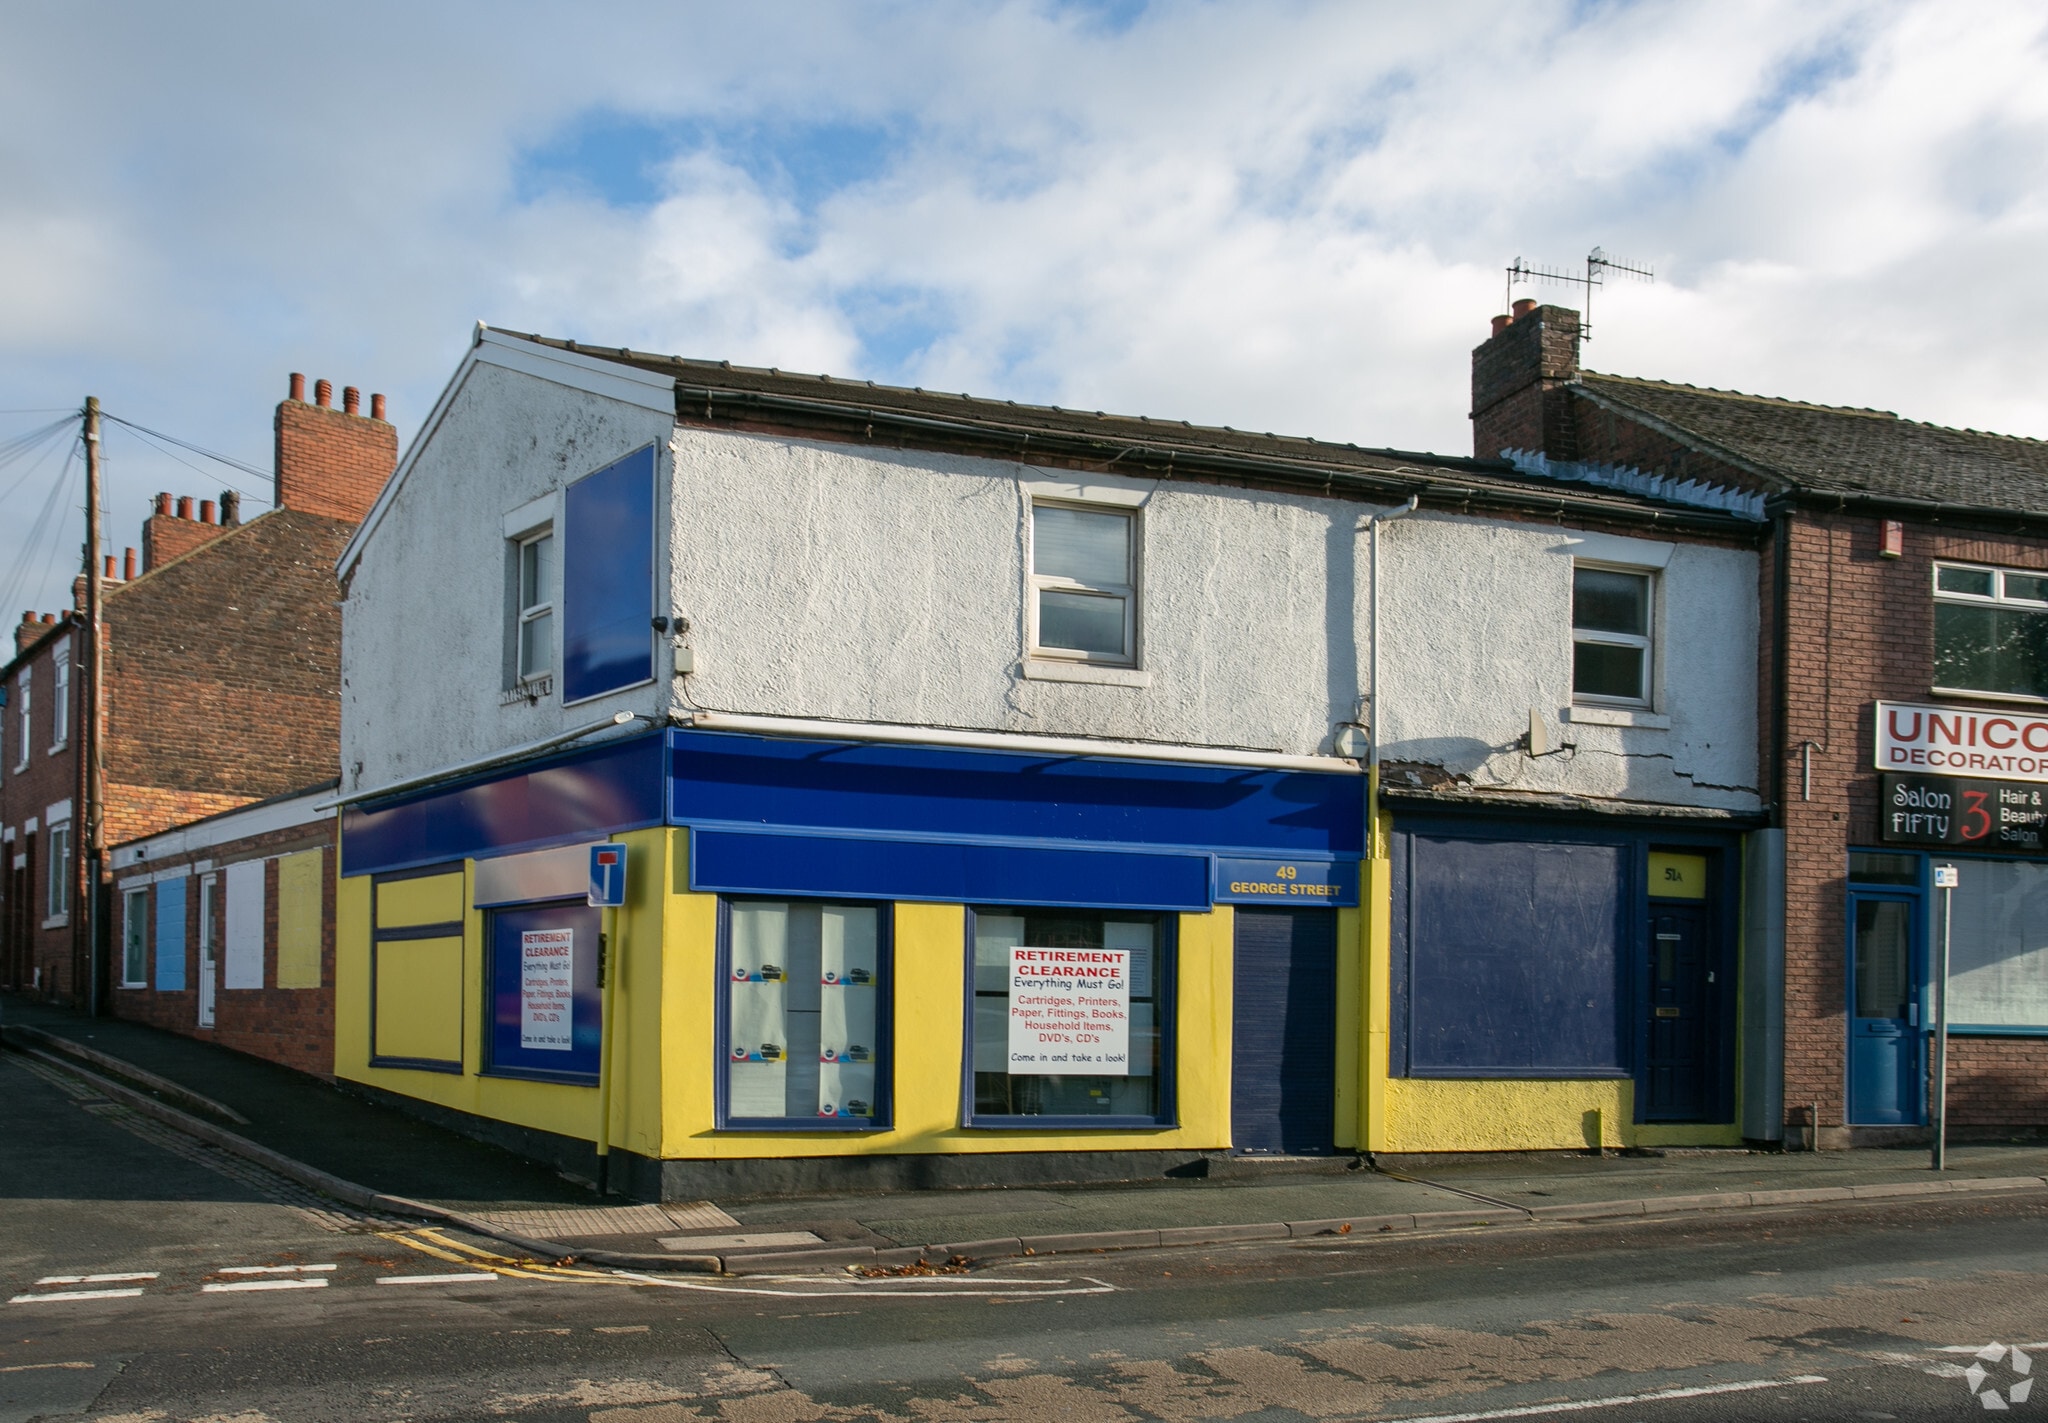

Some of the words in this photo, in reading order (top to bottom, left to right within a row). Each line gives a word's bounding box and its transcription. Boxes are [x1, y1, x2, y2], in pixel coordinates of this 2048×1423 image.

[1889, 710, 2048, 753] UNICO
[1893, 784, 1951, 809] Salon
[2000, 789, 2028, 804] Hair
[2031, 791, 2041, 805] &
[1960, 790, 1991, 840] 3
[2000, 808, 2047, 827] Beauty
[2000, 826, 2038, 842] Salon
[1276, 866, 1296, 880] 49
[1230, 882, 1286, 894] GEORGE
[1290, 884, 1341, 896] STREET
[524, 933, 571, 943] RETIREMENT
[525, 947, 569, 957] CLEARANCE
[1015, 950, 1124, 963] RETIREMENT
[524, 962, 548, 973] Everything
[1018, 965, 1120, 977] CLEARANCE
[1014, 977, 1072, 991] Everything
[1077, 980, 1103, 989] Must
[1108, 979, 1124, 989] Go!
[1018, 995, 1074, 1007] Cartridges,
[1078, 997, 1120, 1007] Printers,
[1012, 1008, 1043, 1019] Paper,
[1048, 1008, 1088, 1020] Fittings,
[1092, 1009, 1127, 1020] Books,
[1025, 1020, 1080, 1030] Household
[1084, 1022, 1113, 1032] Items,
[1039, 1033, 1072, 1043] DVD's,
[1076, 1034, 1100, 1043] CD's
[1011, 1053, 1035, 1061] Come
[1040, 1053, 1047, 1061] in
[1052, 1053, 1067, 1062] and
[1072, 1054, 1092, 1062] take
[1105, 1053, 1125, 1062] look!
